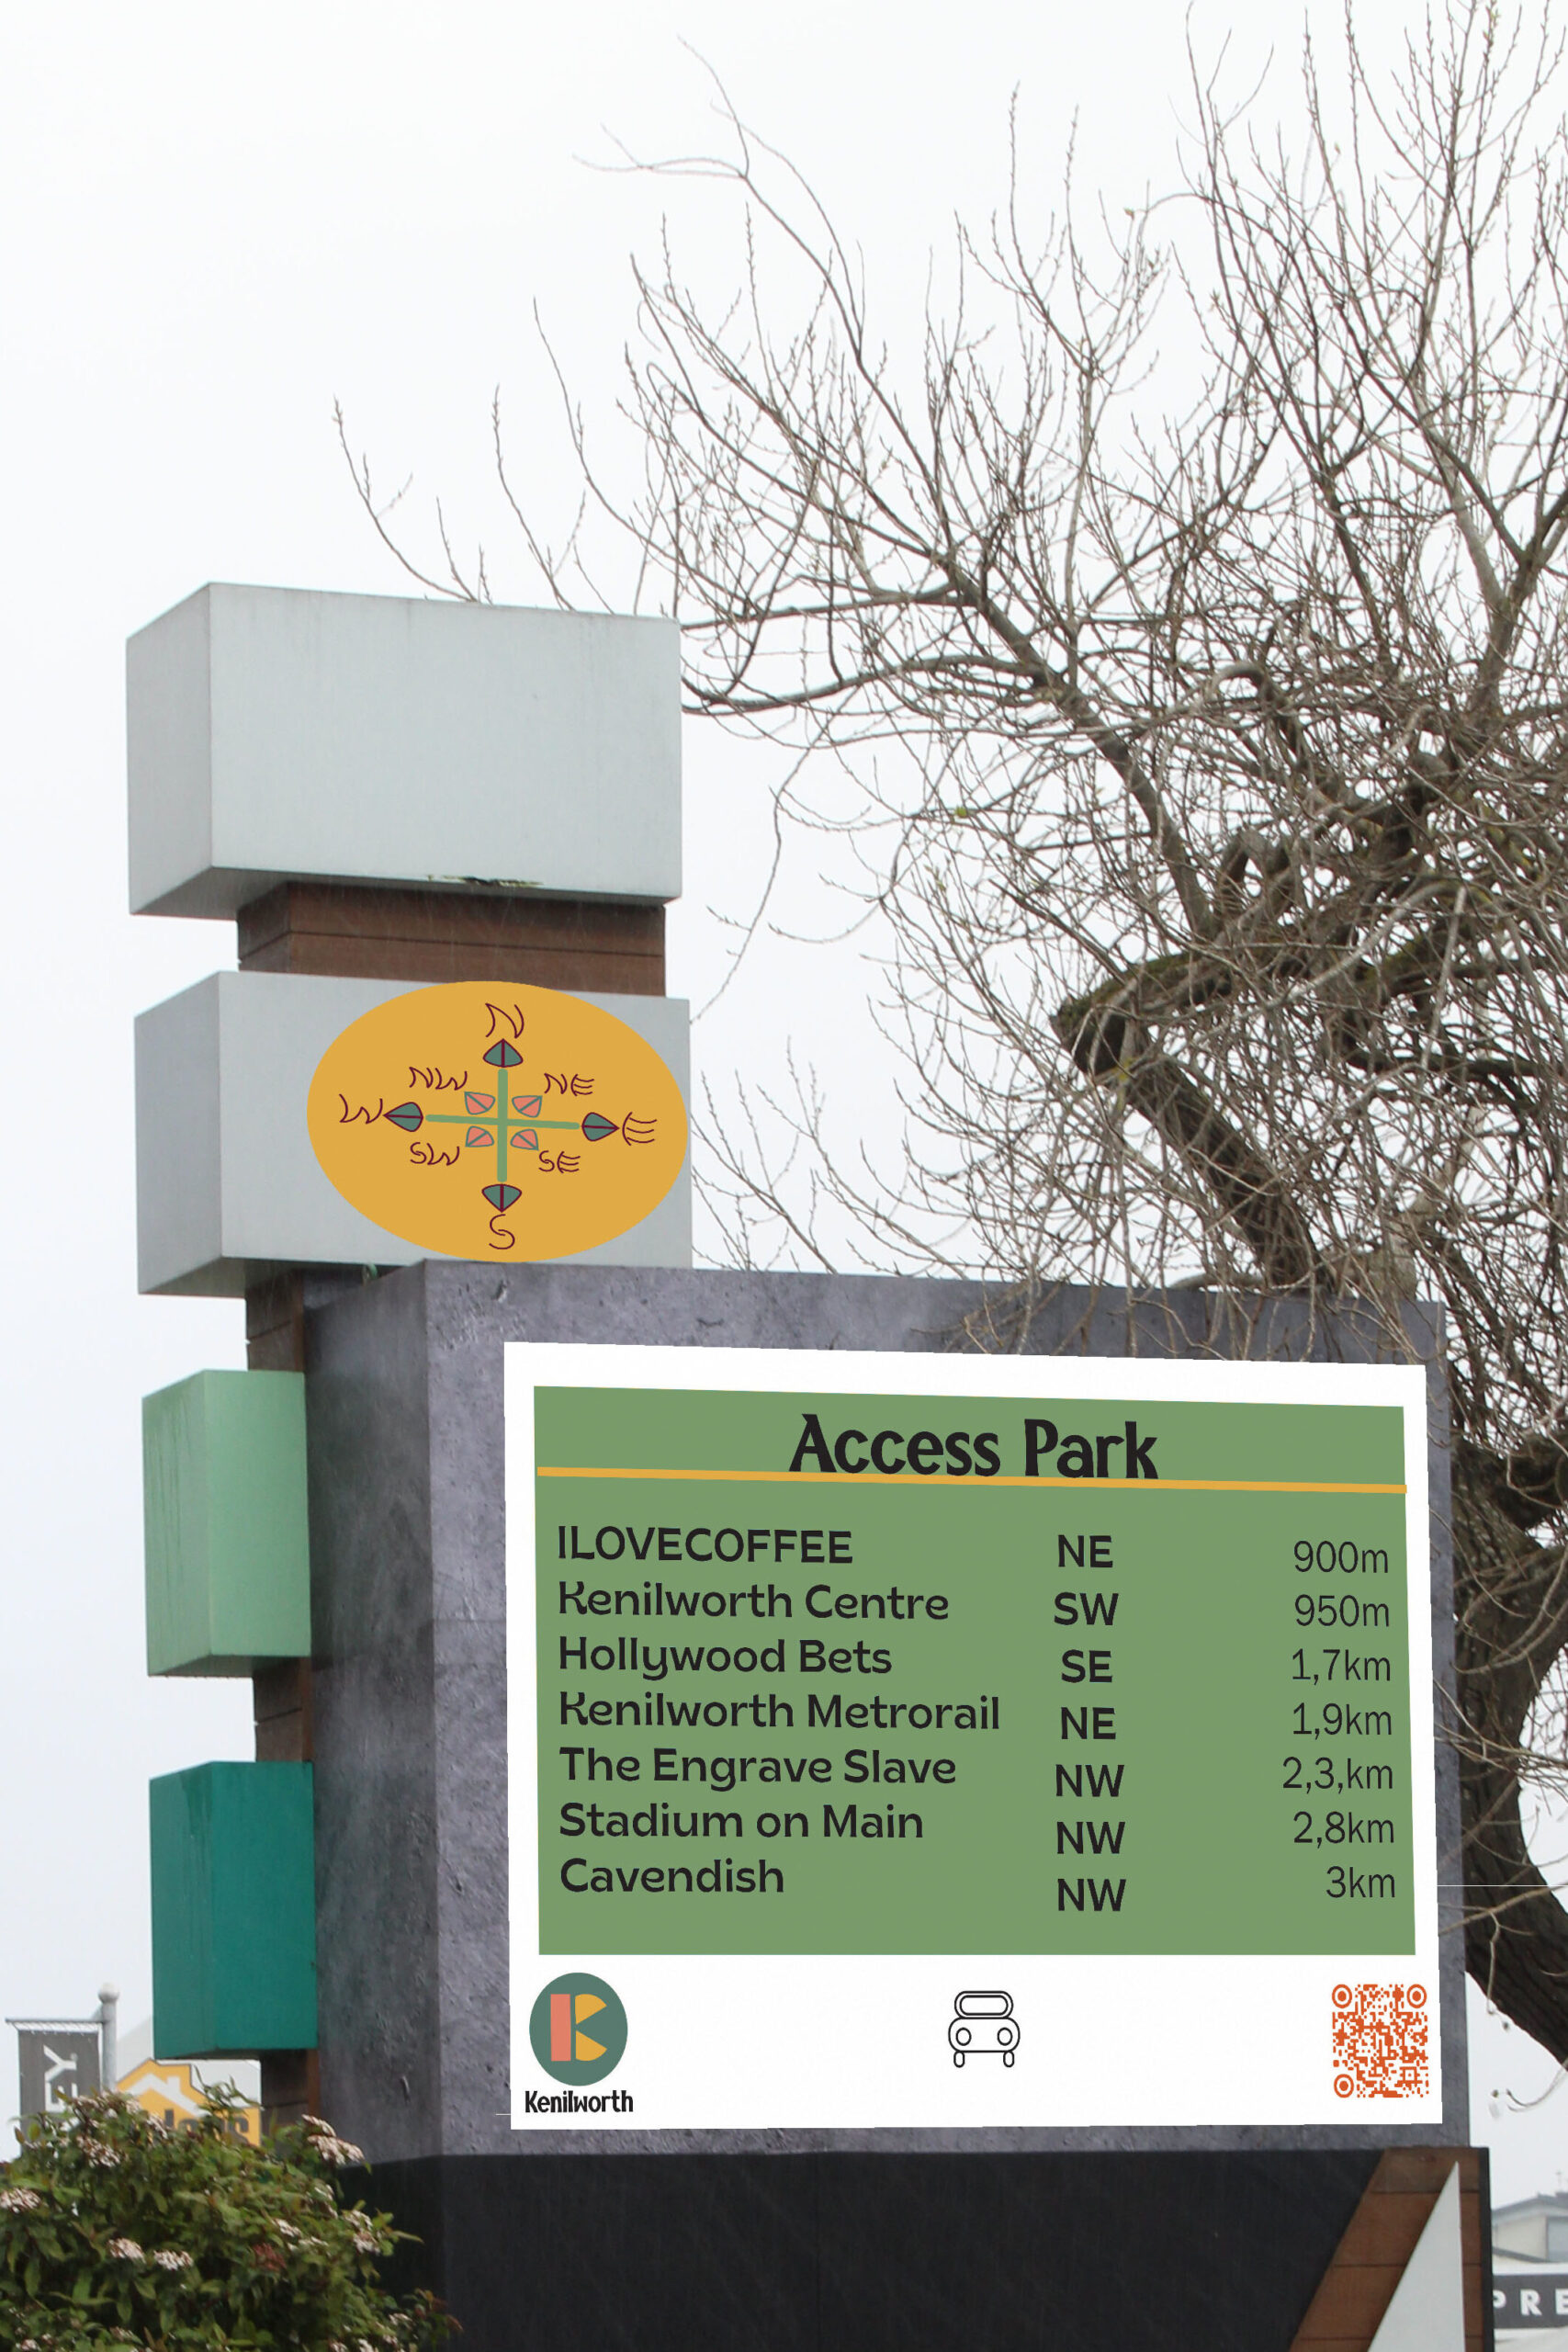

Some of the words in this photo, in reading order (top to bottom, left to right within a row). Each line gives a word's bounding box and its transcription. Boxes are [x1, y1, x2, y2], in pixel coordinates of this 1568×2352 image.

[484, 1002, 525, 1039] N
[409, 1066, 468, 1091] NW
[544, 1073, 594, 1097] NE
[338, 1093, 383, 1124] W
[622, 1112, 658, 1146] E
[410, 1142, 460, 1166] SW
[538, 1150, 581, 1173] SE
[489, 1214, 515, 1250] S
[789, 1413, 1001, 1476] Access
[1023, 1418, 1159, 1479] Park
[558, 1525, 853, 1565] ILOVECOFFEE
[1057, 1533, 1113, 1568] NE
[1293, 1540, 1389, 1574] 900m
[558, 1580, 793, 1618] Kenilworth
[805, 1583, 949, 1621] Centre
[1054, 1591, 1120, 1626] SW
[1294, 1593, 1390, 1628] 950m
[559, 1635, 785, 1681] Hollywood
[799, 1639, 893, 1674] Bets
[1061, 1648, 1113, 1684] SE
[1291, 1647, 1392, 1685] 1,7km
[559, 1690, 795, 1728] Kenilworth
[807, 1693, 1000, 1730] Metrorail
[1060, 1706, 1117, 1740] NE
[1291, 1702, 1393, 1741] 1,9km
[558, 1746, 640, 1782] The
[653, 1747, 832, 1792] Engrave
[844, 1748, 956, 1784] Slave
[1055, 1763, 1125, 1798] NW
[1282, 1756, 1394, 1795] 2,3,km
[559, 1802, 743, 1838] Stadium
[756, 1812, 809, 1838] on
[822, 1804, 923, 1838] Main
[1056, 1821, 1126, 1855] NW
[1292, 1811, 1395, 1849] 2,8km
[560, 1857, 784, 1894] Cavendish
[1057, 1878, 1127, 1912] NW
[1325, 1865, 1396, 1899] 3km
[525, 2089, 634, 2113] Kenilworth
